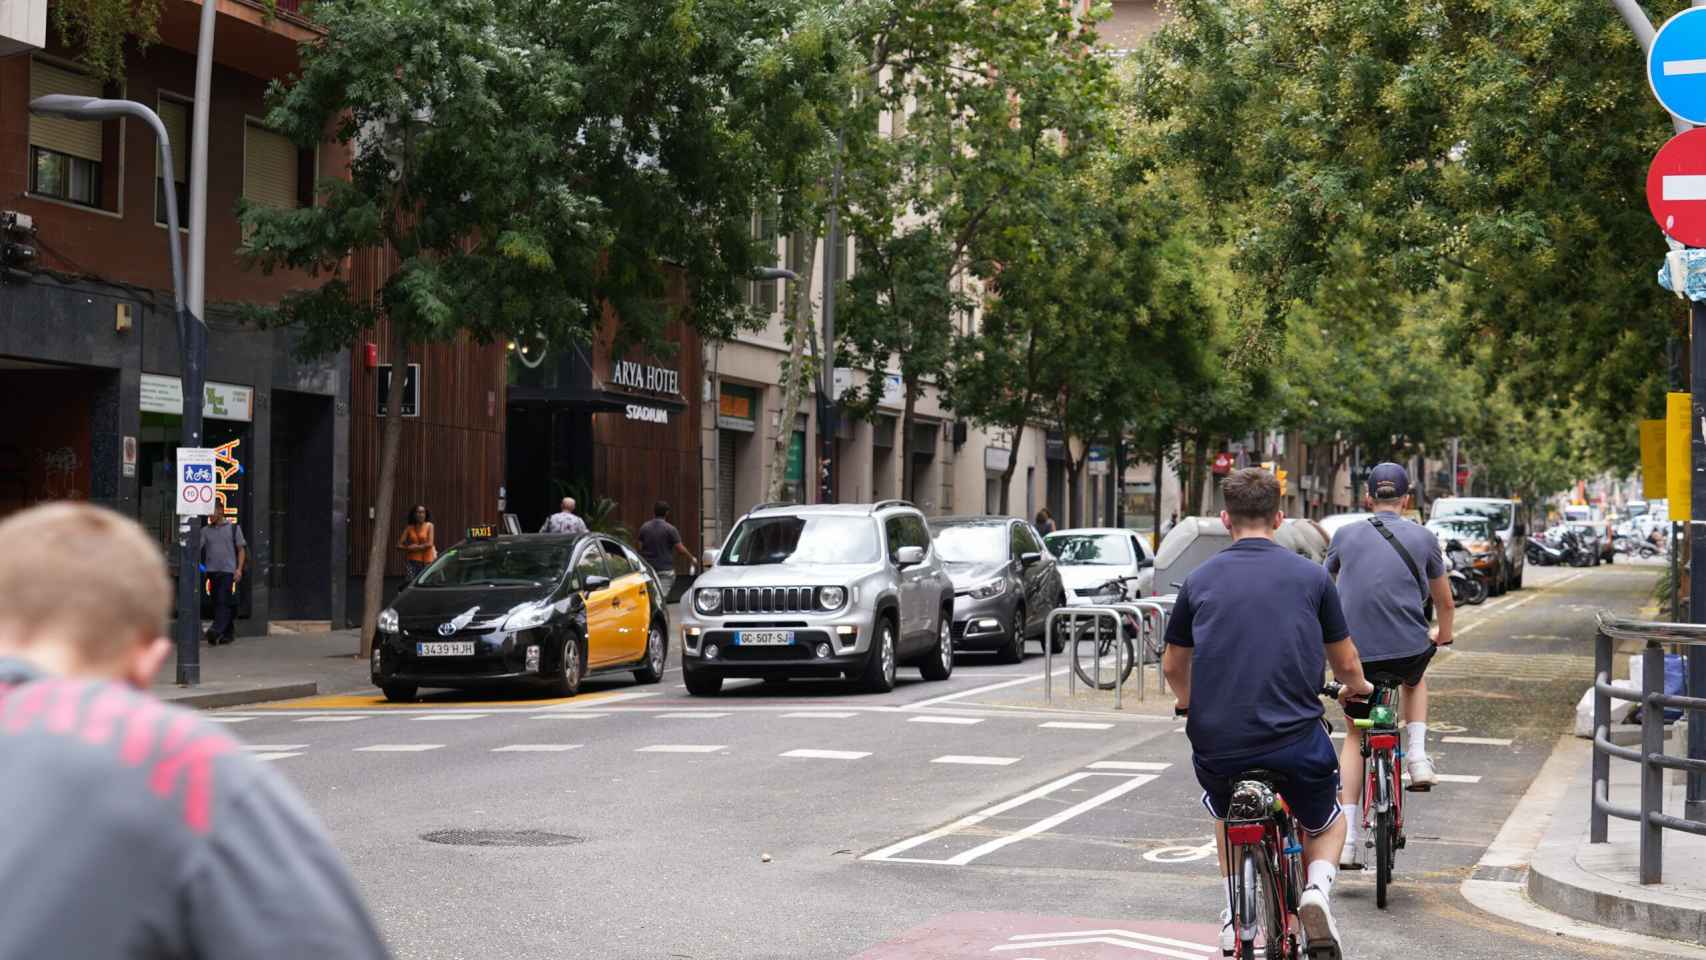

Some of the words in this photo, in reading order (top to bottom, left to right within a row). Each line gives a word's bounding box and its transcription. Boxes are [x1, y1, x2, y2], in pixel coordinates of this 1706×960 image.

[614, 360, 643, 388] ARYA
[647, 366, 679, 394] HOTEL
[625, 404, 668, 424] STADIUM
[471, 527, 487, 537] TAXI
[423, 644, 449, 654] 3439
[452, 644, 473, 654] HJH
